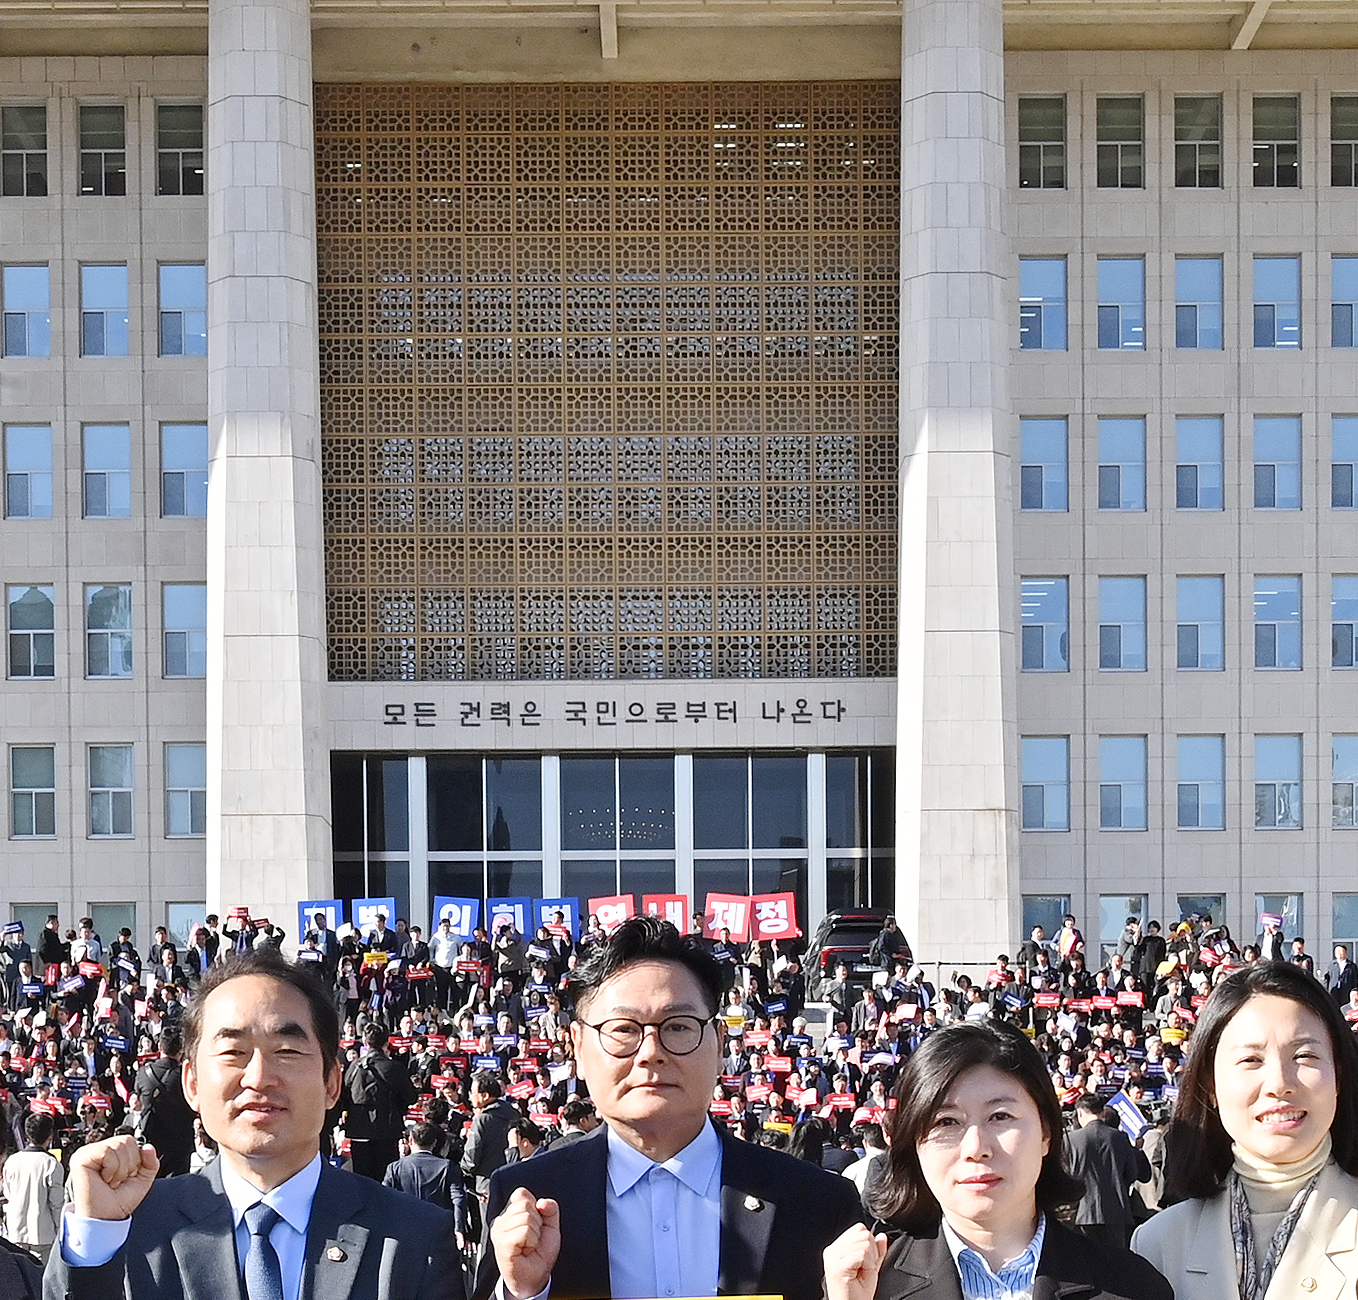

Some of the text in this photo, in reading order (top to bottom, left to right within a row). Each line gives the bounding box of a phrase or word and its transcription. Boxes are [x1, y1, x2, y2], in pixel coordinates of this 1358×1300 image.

[383, 698, 847, 728] 모든 권력은 국민으로부터 나온다
[708, 900, 789, 935] 제정
